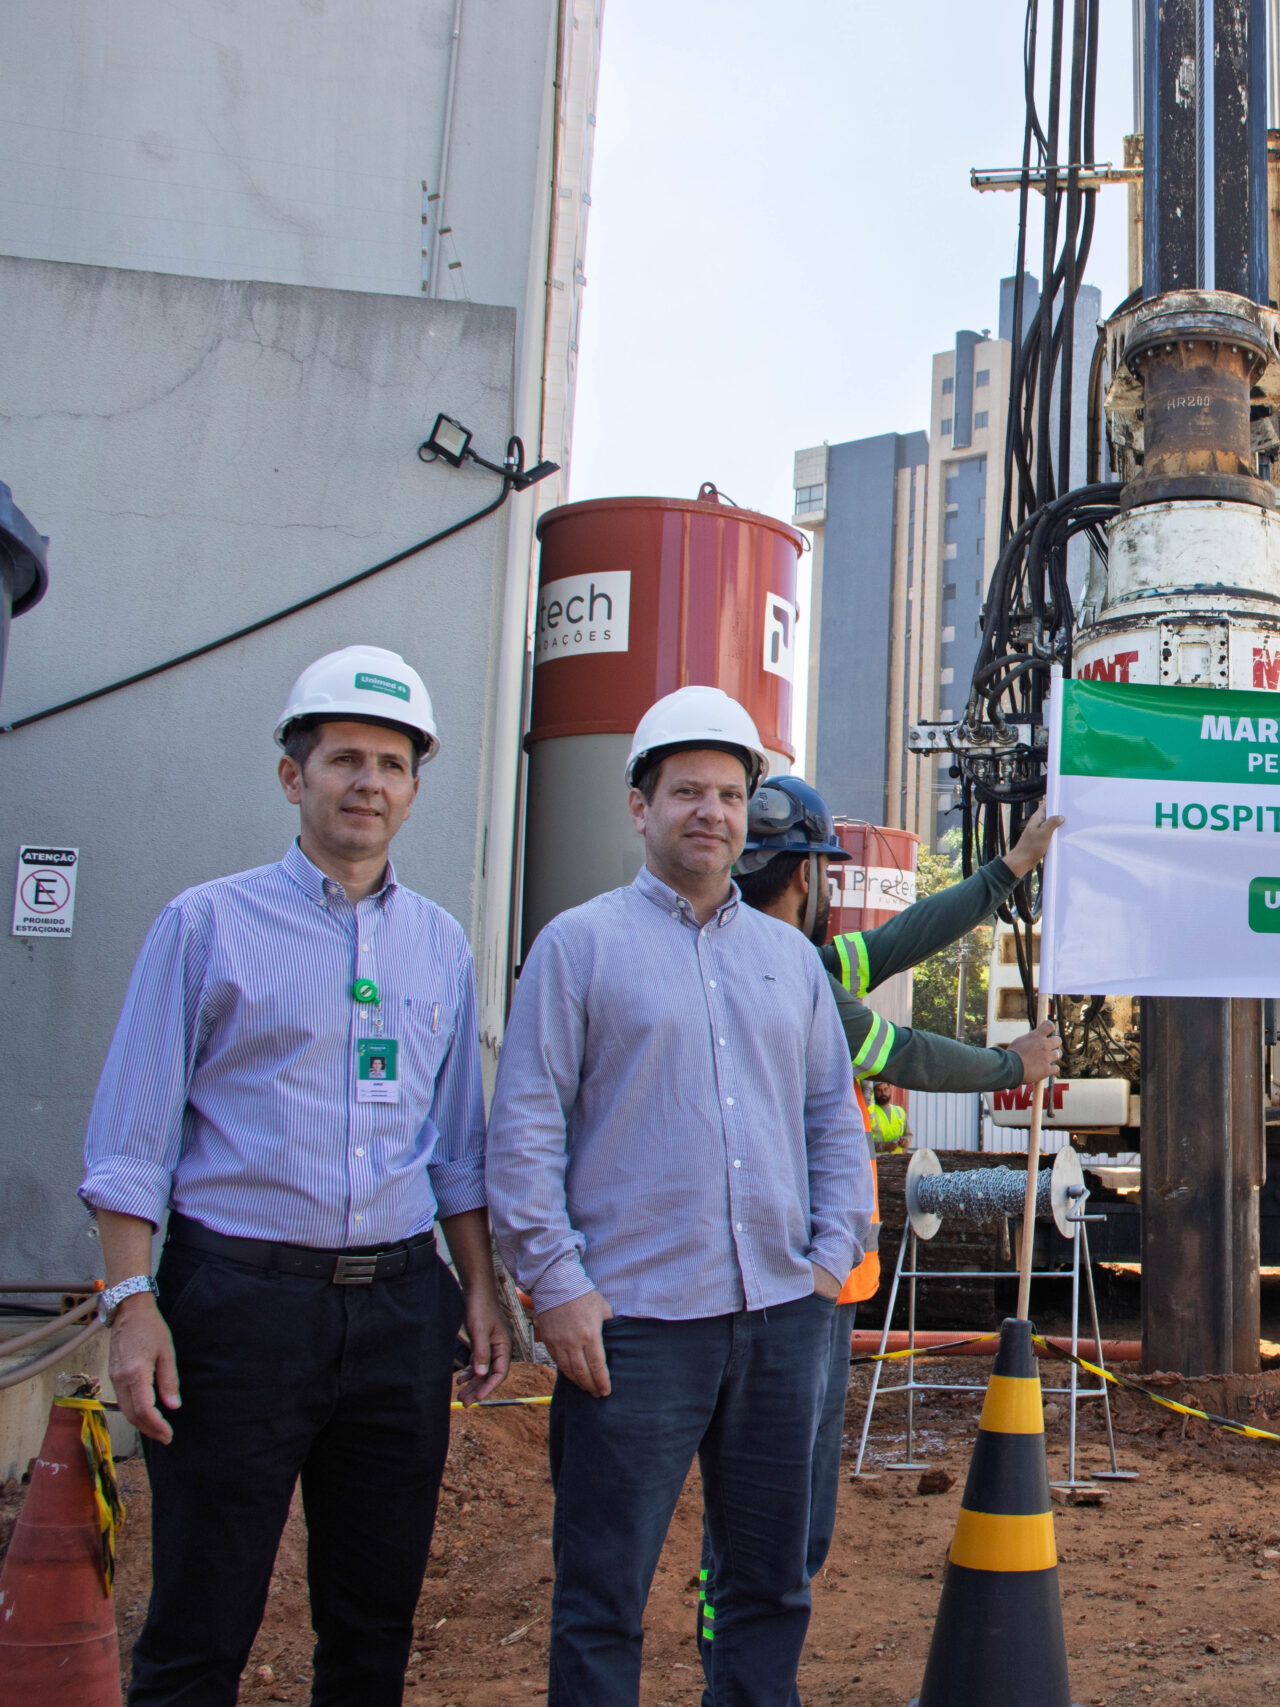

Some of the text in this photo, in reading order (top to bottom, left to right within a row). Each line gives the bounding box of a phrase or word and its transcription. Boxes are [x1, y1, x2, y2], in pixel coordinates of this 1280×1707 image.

[1167, 395, 1210, 411] HR200
[540, 583, 613, 632] tech
[24, 852, 75, 863] ATENÇÃO
[34, 879, 57, 905] E
[23, 917, 65, 925] PROIBIDO
